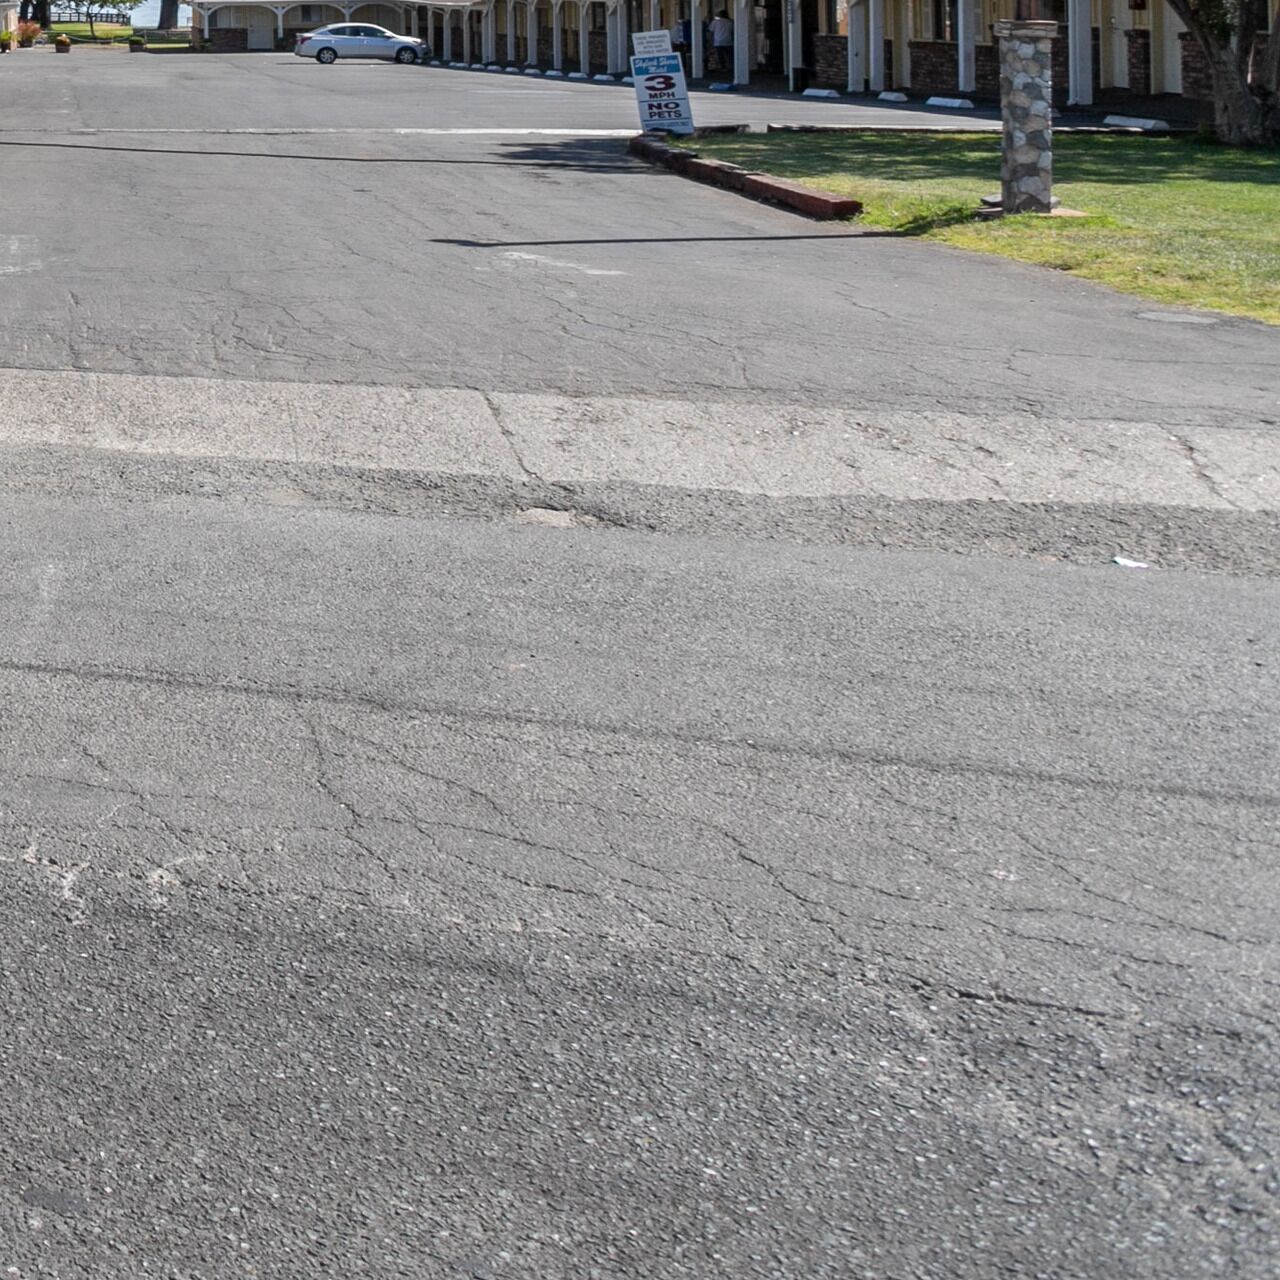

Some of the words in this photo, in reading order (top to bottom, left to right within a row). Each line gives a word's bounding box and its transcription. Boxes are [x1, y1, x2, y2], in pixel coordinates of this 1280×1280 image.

[644, 75, 676, 92] 3
[648, 102, 679, 110] NO
[649, 110, 681, 118] PETS
